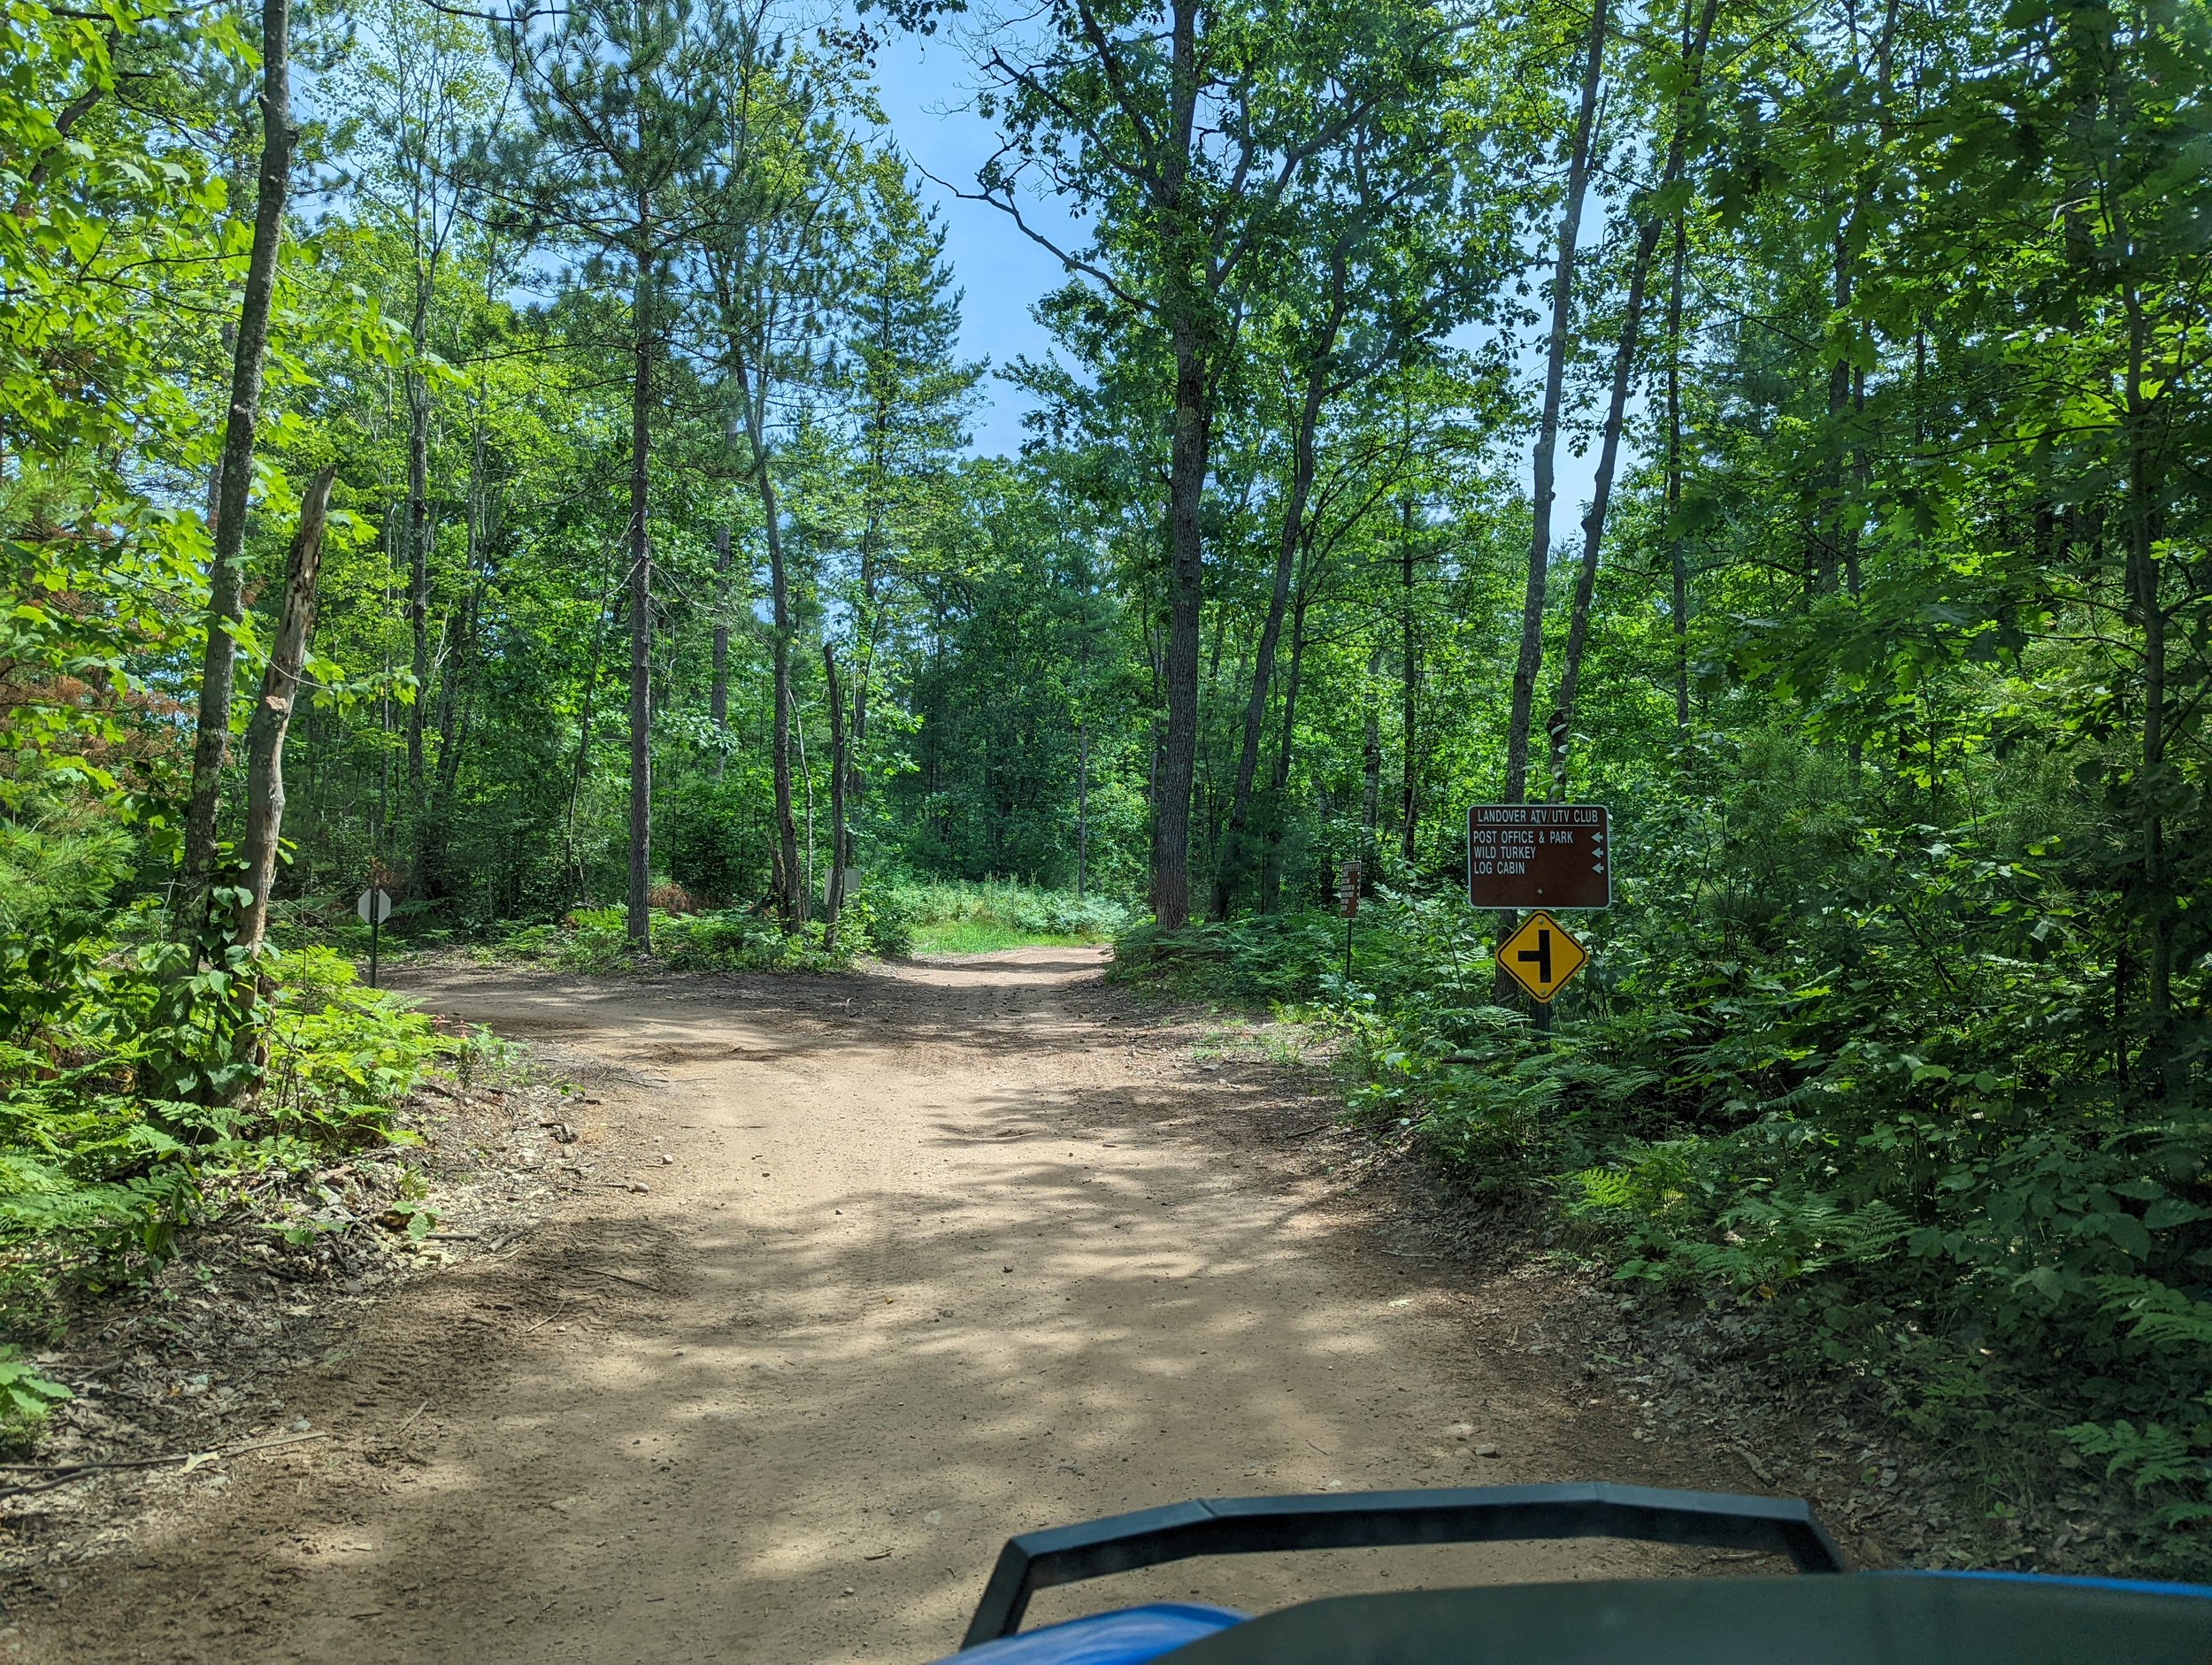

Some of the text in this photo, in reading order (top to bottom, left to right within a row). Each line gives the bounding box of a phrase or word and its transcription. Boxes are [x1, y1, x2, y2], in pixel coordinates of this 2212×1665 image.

[1478, 809, 1599, 823] LANDOVER ATV/UTV CLUB
[1473, 831, 1573, 844] POST OFFICE & PARK
[1474, 846, 1536, 859] WILD TURKEY
[1474, 862, 1525, 875] LOG CABIN
